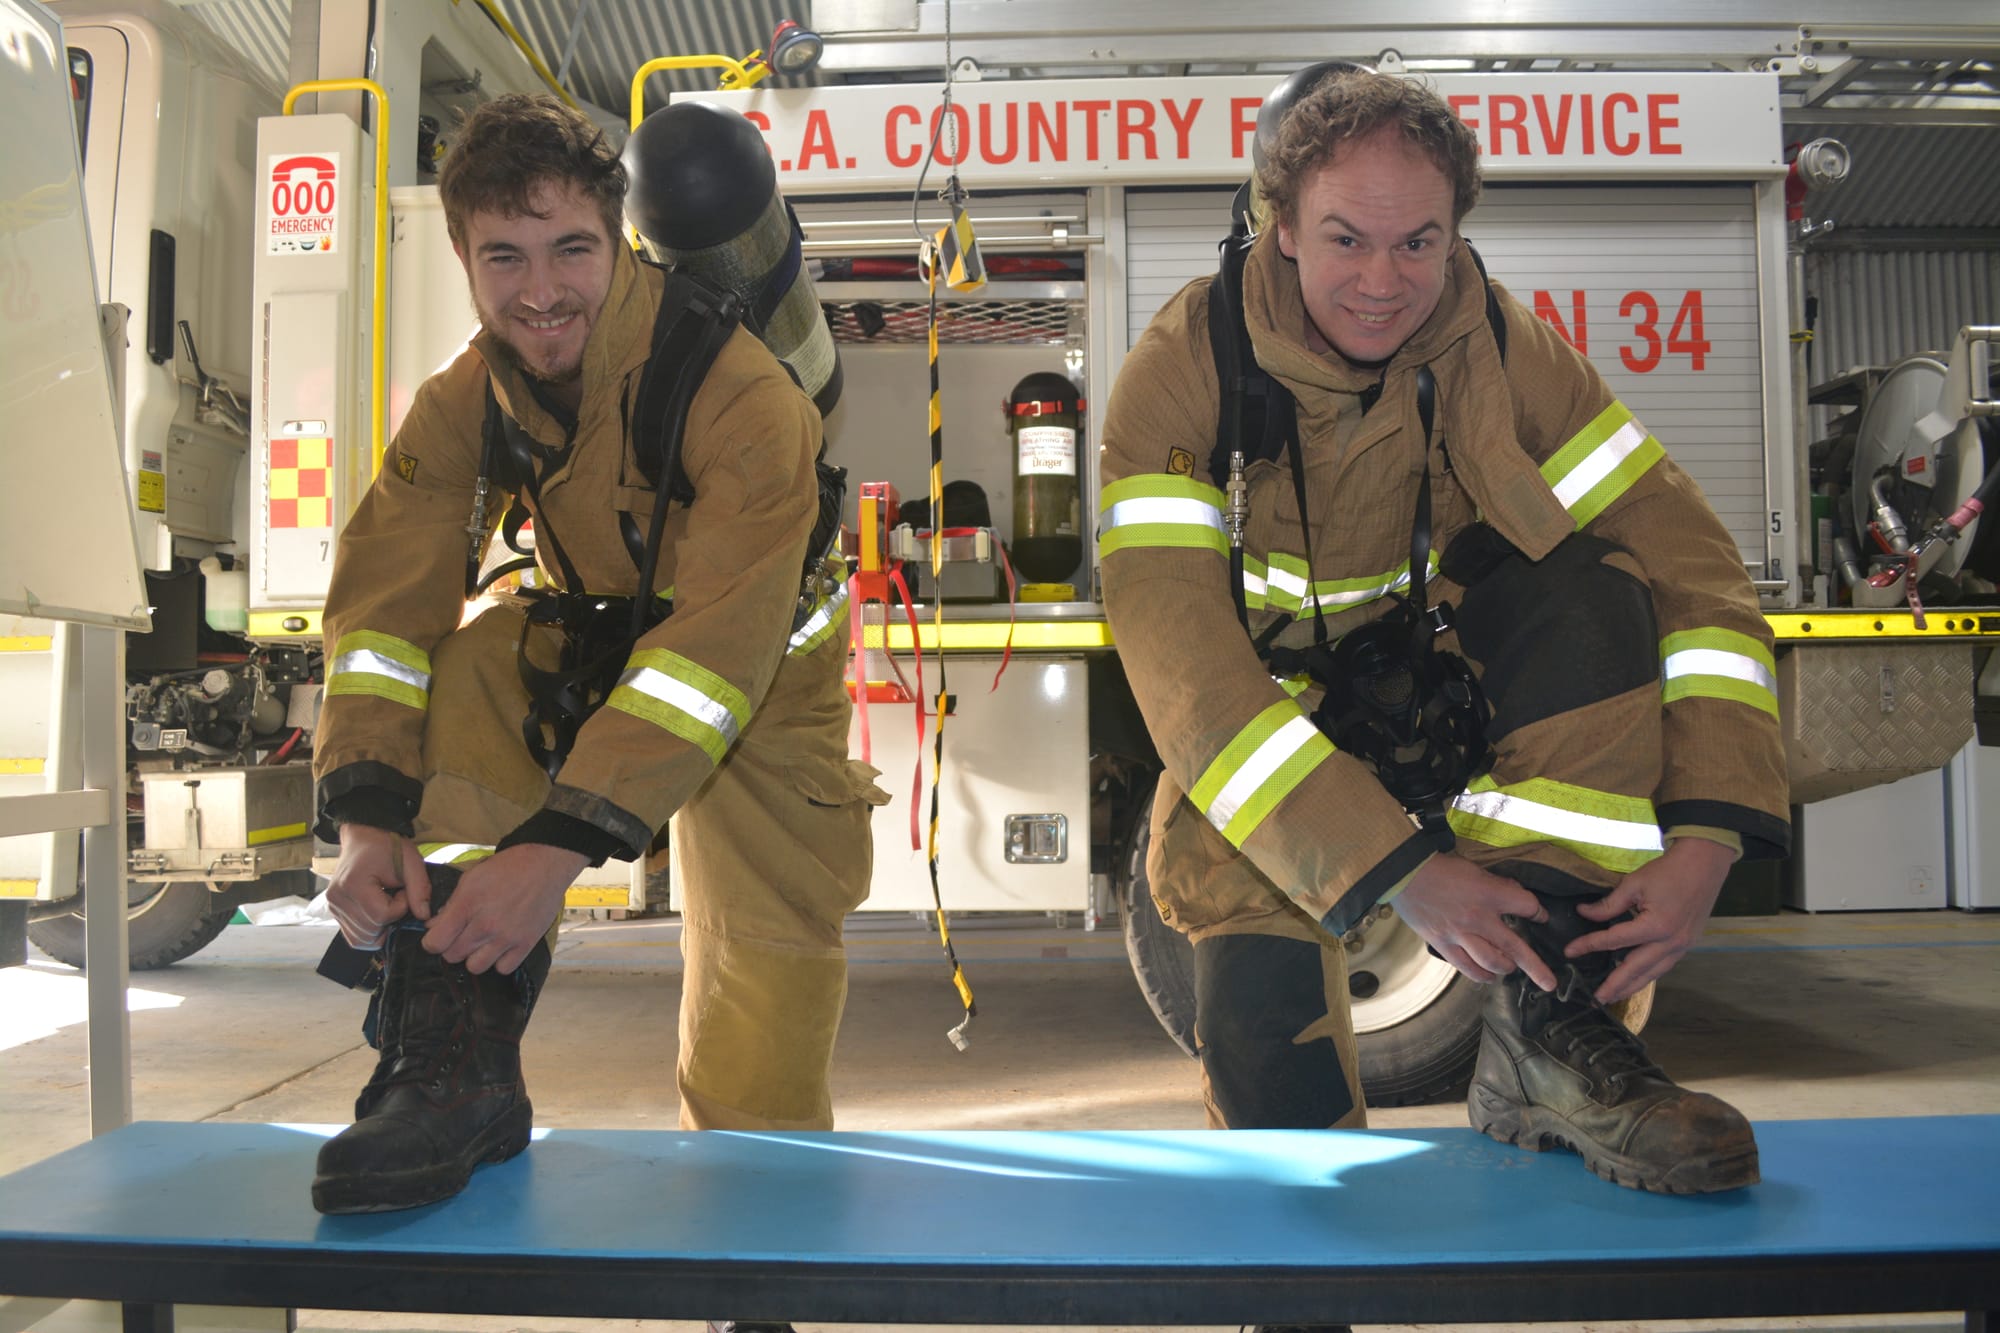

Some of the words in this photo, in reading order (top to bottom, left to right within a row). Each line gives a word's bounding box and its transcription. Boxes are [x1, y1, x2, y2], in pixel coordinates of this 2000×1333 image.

[884, 97, 1205, 169] COUNTRY
[1447, 92, 1683, 157] ERVICE
[272, 180, 335, 216] 000
[271, 218, 334, 233] EMERGENCY
[1618, 289, 1712, 374] 34
[1771, 511, 1781, 533] 5
[320, 541, 329, 562] 7
